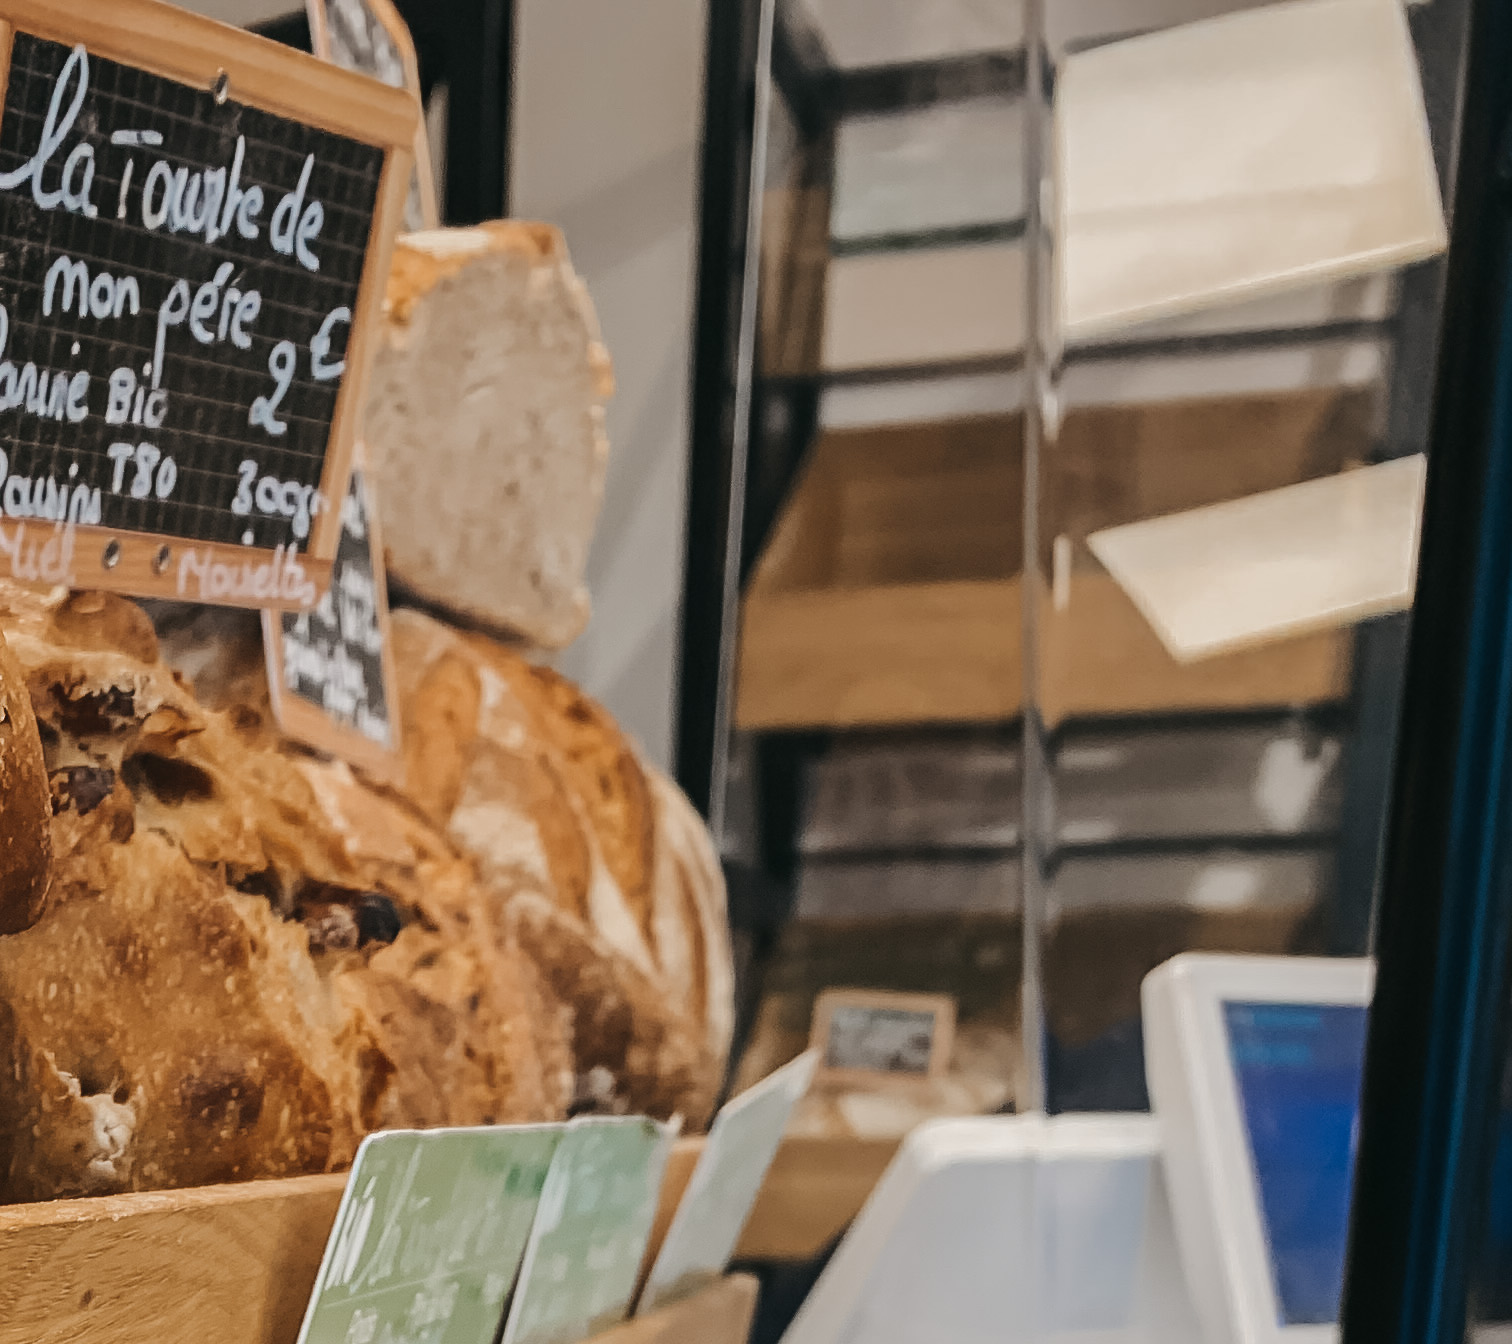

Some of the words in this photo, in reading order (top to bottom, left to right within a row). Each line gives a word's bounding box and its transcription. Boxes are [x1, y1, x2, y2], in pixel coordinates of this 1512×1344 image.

[270, 153, 324, 271] de
[43, 254, 141, 319] mon
[105, 361, 169, 428] Bio
[107, 442, 177, 500] T80
